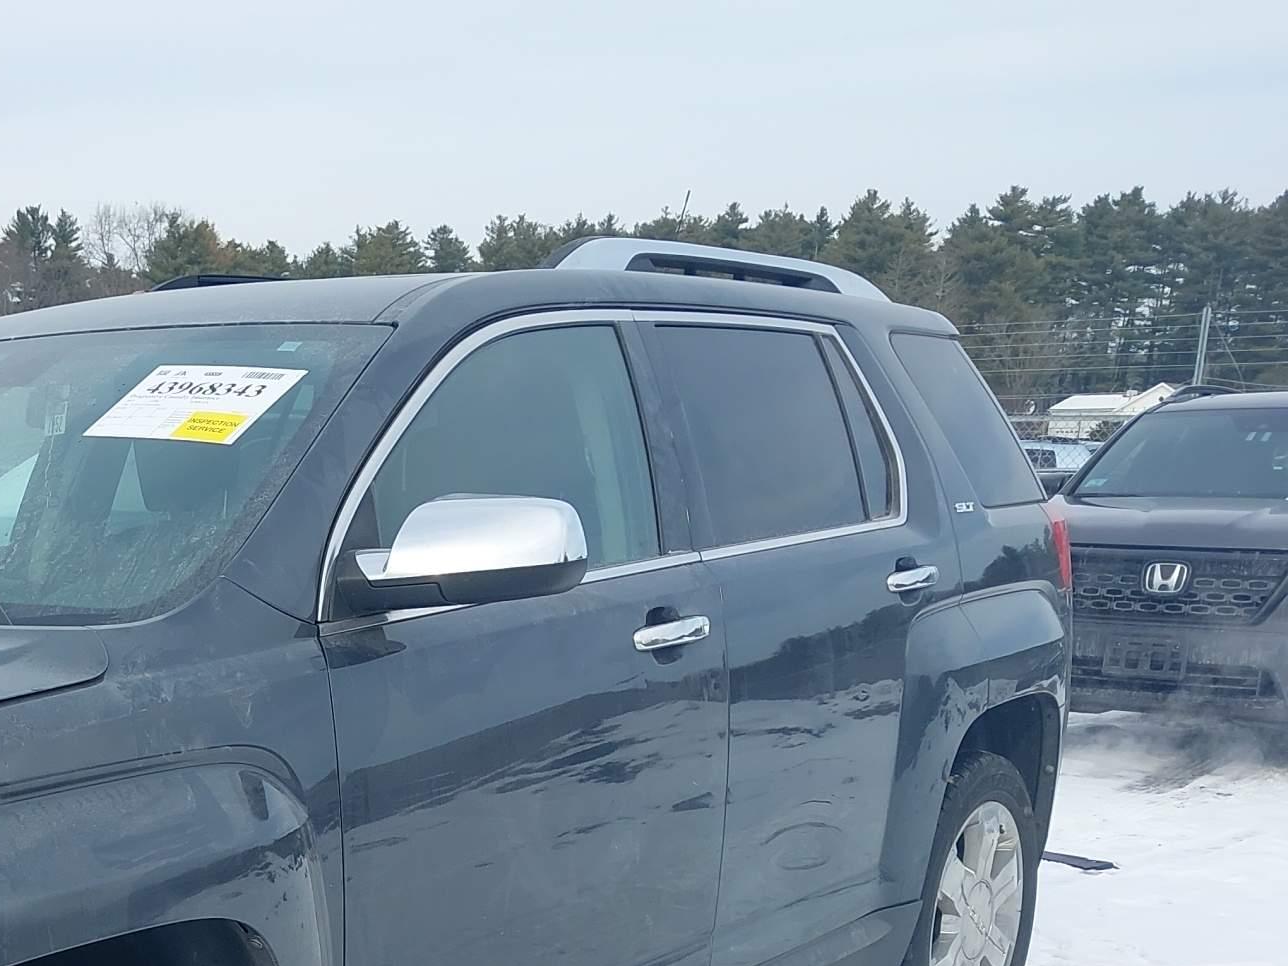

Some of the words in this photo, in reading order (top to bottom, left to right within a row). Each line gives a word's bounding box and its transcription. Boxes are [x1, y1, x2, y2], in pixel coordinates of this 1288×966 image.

[146, 381, 267, 398] 43968343
[186, 417, 240, 428] INSPECTION
[186, 425, 226, 434] SERVICE
